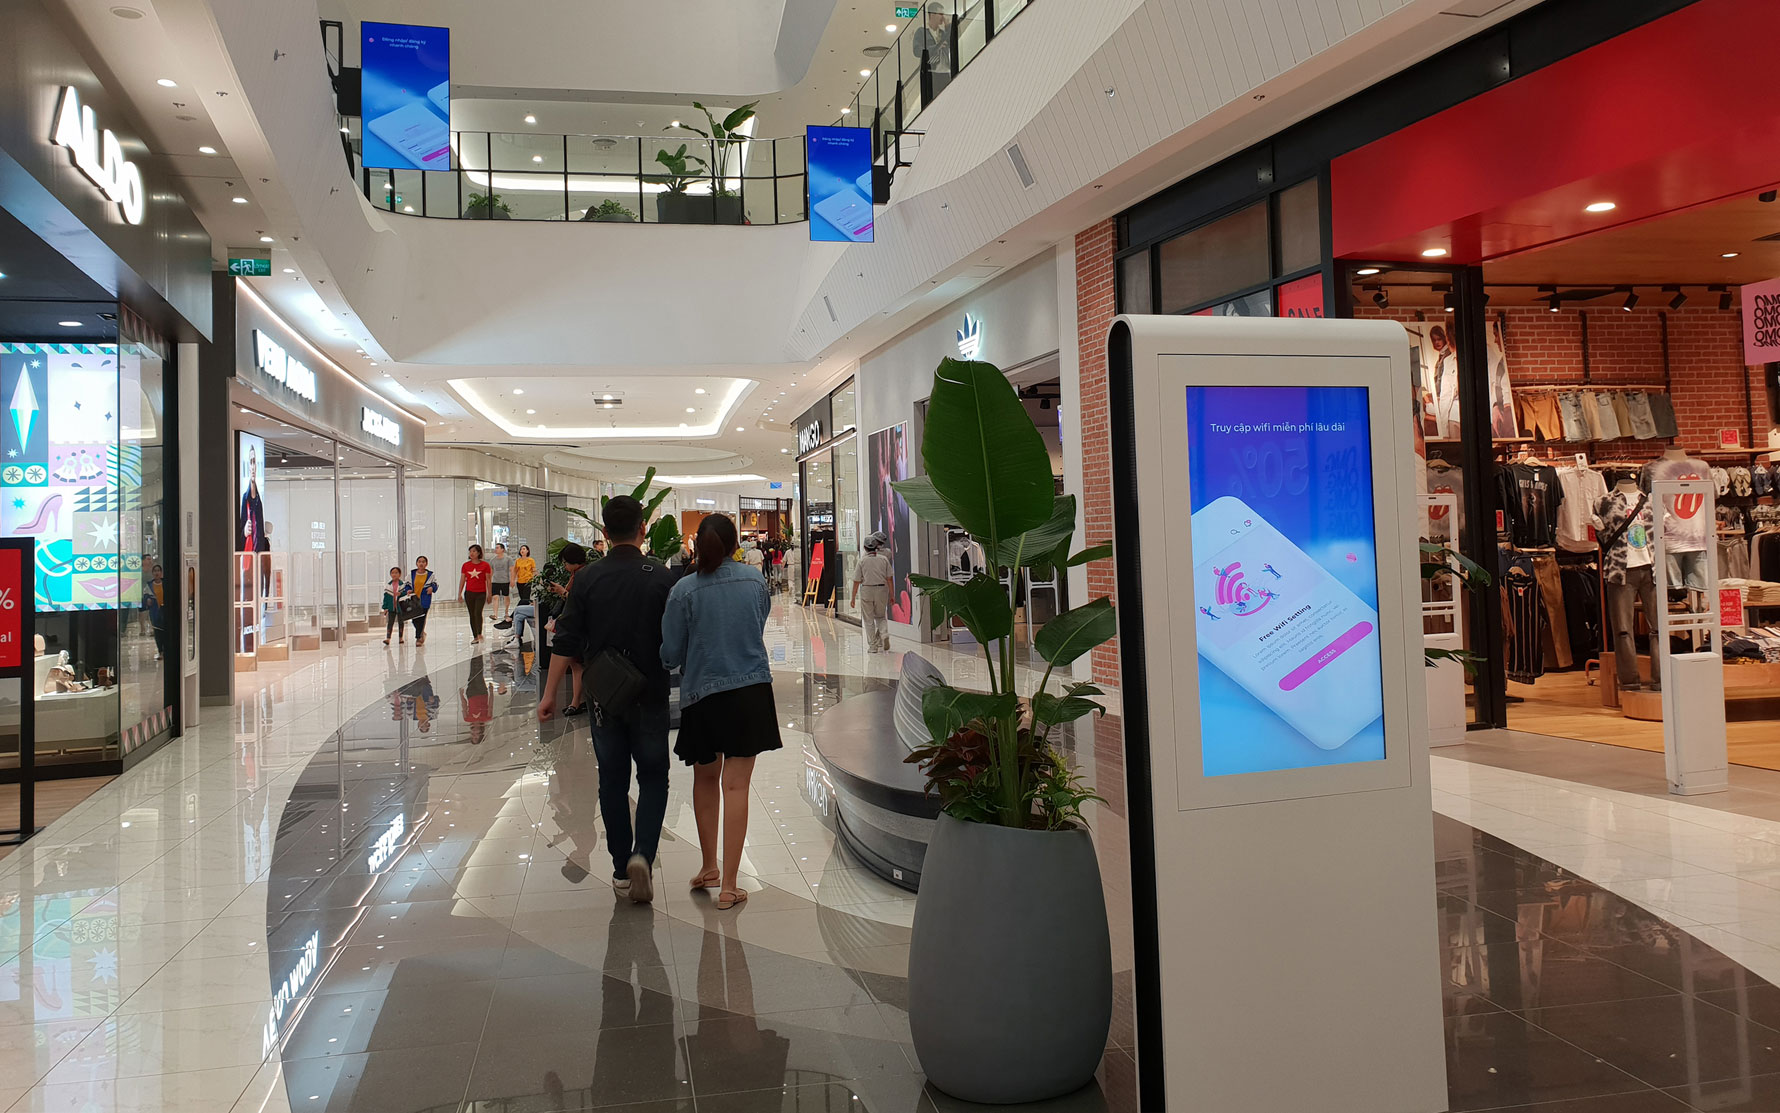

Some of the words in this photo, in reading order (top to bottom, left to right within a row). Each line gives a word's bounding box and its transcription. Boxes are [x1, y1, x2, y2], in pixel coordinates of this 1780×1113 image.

[53, 84, 143, 226] ALDO
[1210, 423, 1231, 434] Truy
[1233, 422, 1251, 434] cập
[1253, 422, 1271, 432] wifi
[1272, 421, 1297, 432] miễn
[1298, 422, 1314, 434] phí
[1315, 422, 1329, 432] lâu
[1331, 422, 1345, 432] dài
[1258, 630, 1274, 642] Free
[1287, 605, 1311, 621] Setting
[1317, 648, 1337, 664] ACCESS
